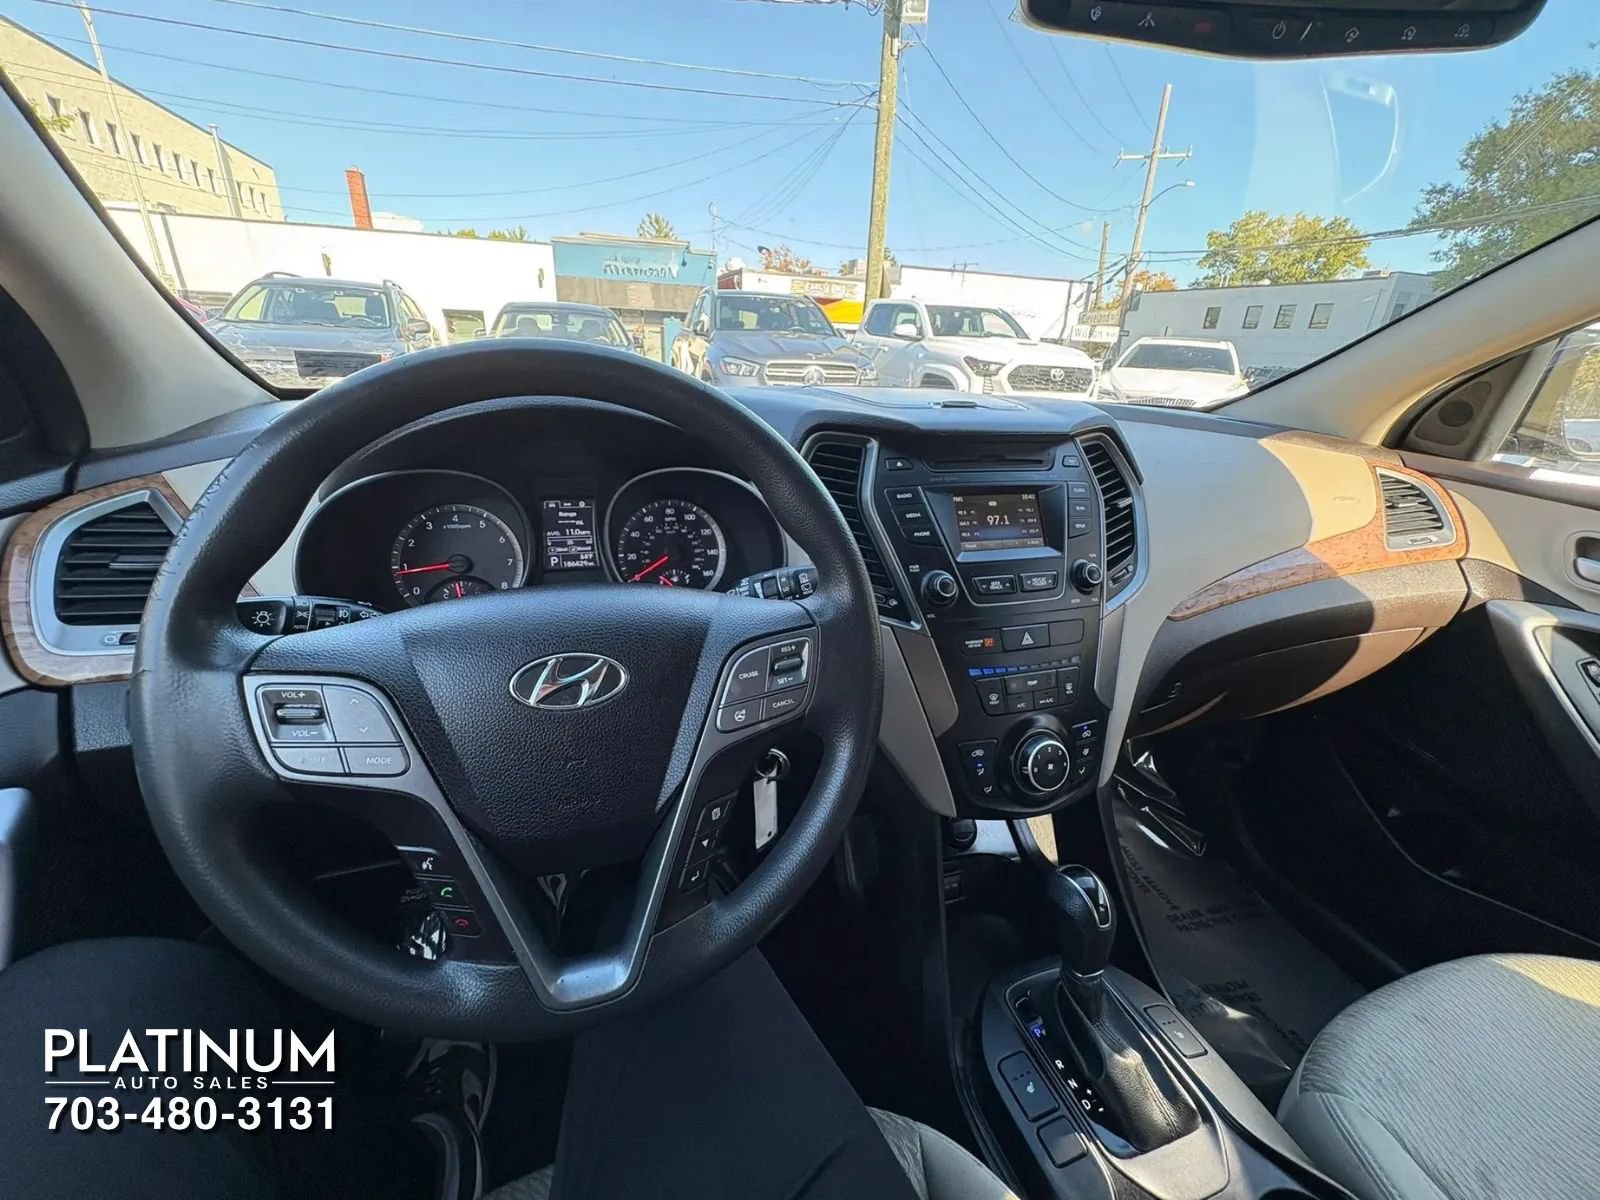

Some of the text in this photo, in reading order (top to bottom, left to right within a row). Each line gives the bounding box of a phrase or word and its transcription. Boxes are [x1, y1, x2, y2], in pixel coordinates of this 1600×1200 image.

[452, 514, 459, 522] 4
[986, 514, 1010, 525] 97.1
[425, 521, 433, 530] 3
[479, 520, 486, 528] 5
[408, 539, 415, 547] 2
[499, 536, 506, 544] 6
[550, 556, 559, 567] P
[403, 563, 409, 571] 1
[501, 581, 508, 589] 8
[413, 587, 420, 595] 0
[738, 671, 759, 680] CRUISE
[281, 691, 305, 699] VOL+
[772, 699, 796, 709] CANCEL
[366, 757, 393, 765] MODE
[1055, 1059, 1064, 1070] R
[1067, 1078, 1078, 1089] N
[1081, 1099, 1091, 1110] D
